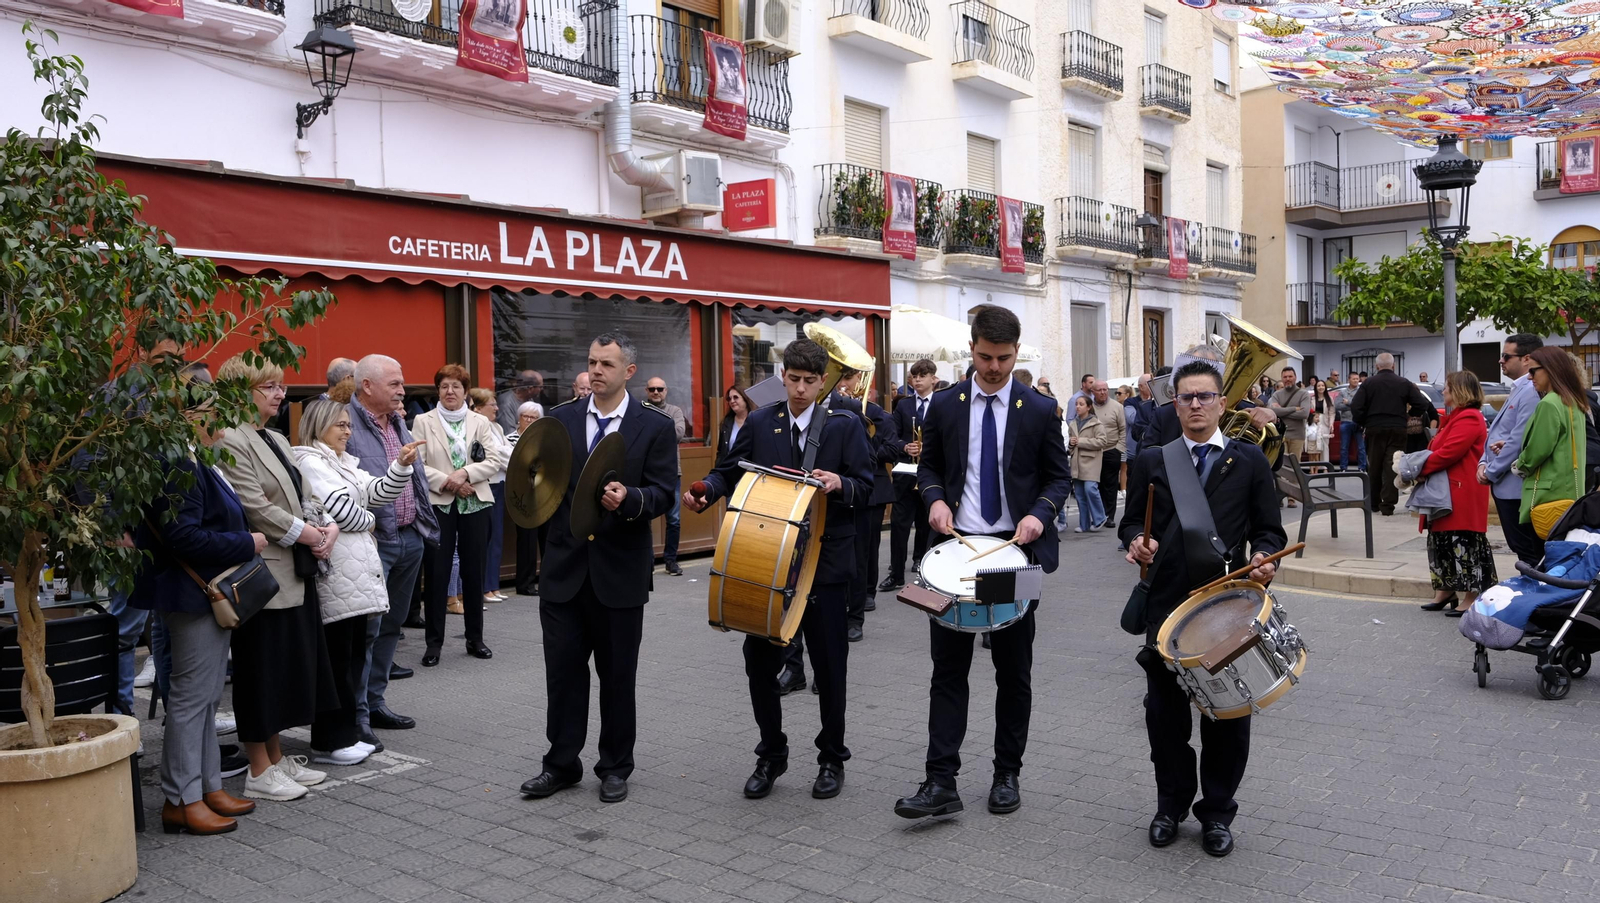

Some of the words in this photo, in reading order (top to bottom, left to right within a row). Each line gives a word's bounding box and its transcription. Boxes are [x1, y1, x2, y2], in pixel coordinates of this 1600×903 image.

[732, 192, 741, 200] LA
[742, 189, 764, 198] PLAZA
[735, 199, 762, 208] CAFETERÍA
[388, 235, 492, 262] CAFETERIA
[499, 221, 555, 269] LA
[566, 229, 688, 280] PLAZA
[1476, 330, 1485, 338] 12
